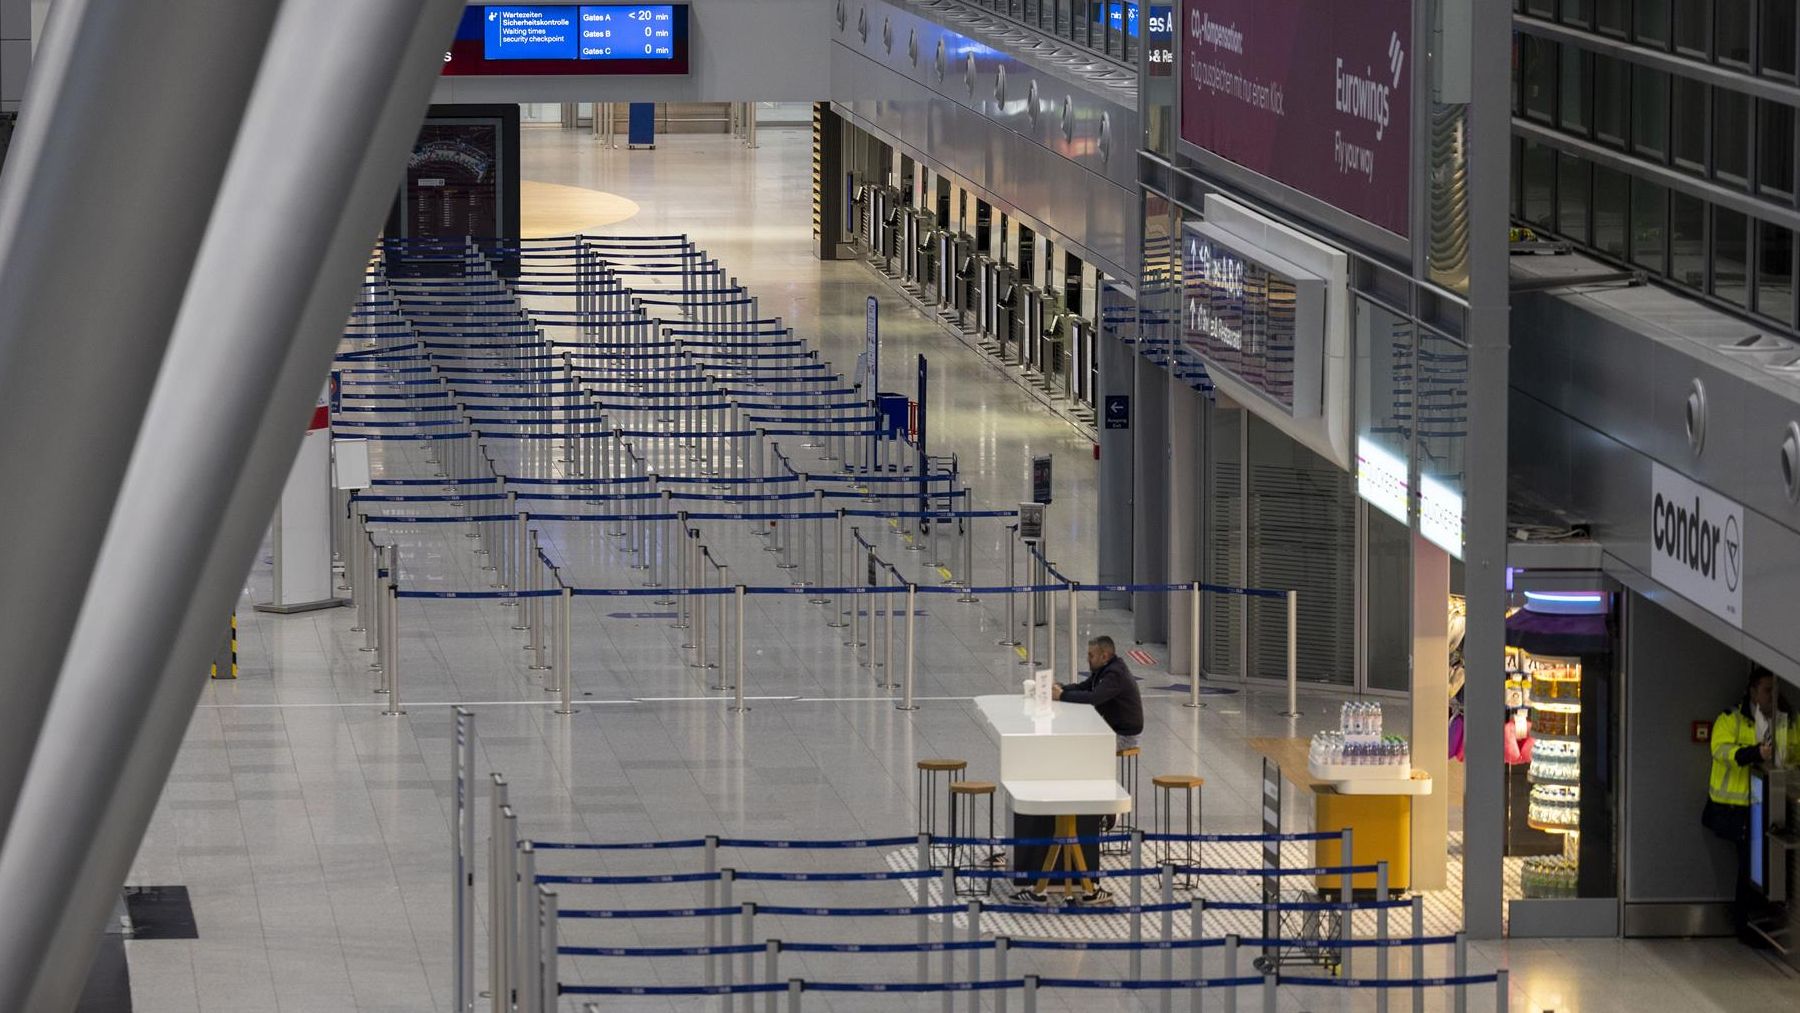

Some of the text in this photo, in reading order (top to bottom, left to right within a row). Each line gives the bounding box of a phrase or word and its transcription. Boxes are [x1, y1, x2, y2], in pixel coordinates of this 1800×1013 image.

[638, 10, 652, 20] 20
[1149, 17, 1165, 32] es
[502, 28, 527, 36] Waiting
[583, 30, 604, 38] Gates
[605, 30, 611, 38] B
[644, 26, 652, 37] 0
[502, 35, 565, 44] security checkpoint
[583, 43, 669, 55] Gates C 0 min
[443, 51, 452, 62] s
[1162, 49, 1173, 63] Re
[1336, 57, 1390, 141] Eurowings
[1344, 142, 1360, 174] your
[1360, 147, 1374, 184] way
[1654, 493, 1720, 580] condor
